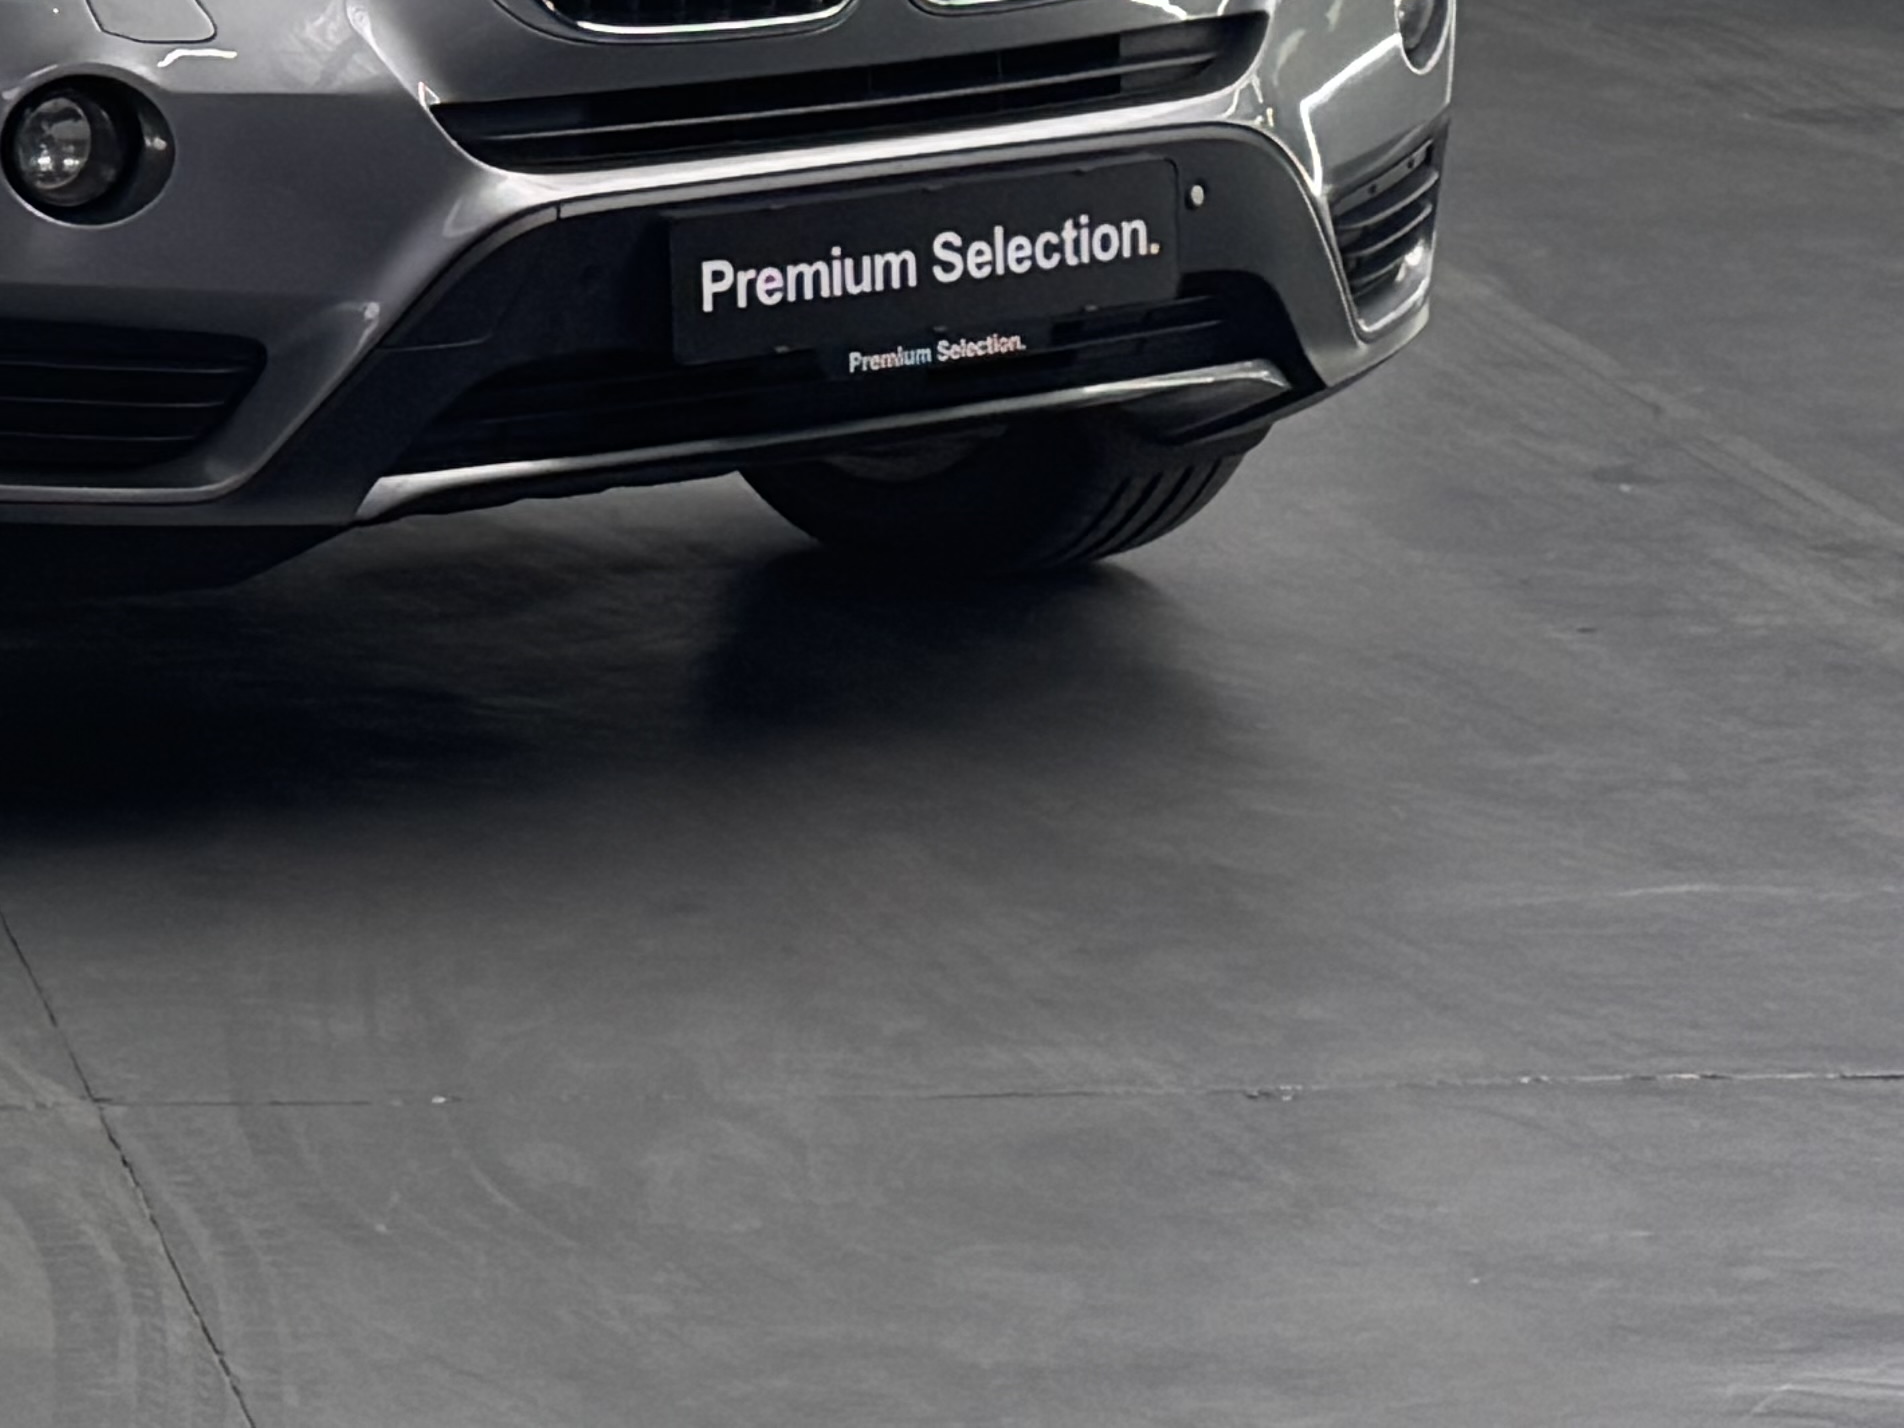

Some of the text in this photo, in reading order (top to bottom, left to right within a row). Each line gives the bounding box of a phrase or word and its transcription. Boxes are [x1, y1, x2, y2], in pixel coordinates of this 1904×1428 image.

[701, 213, 1161, 312] Premium Selection.
[848, 332, 1027, 374] Premium Selection.
